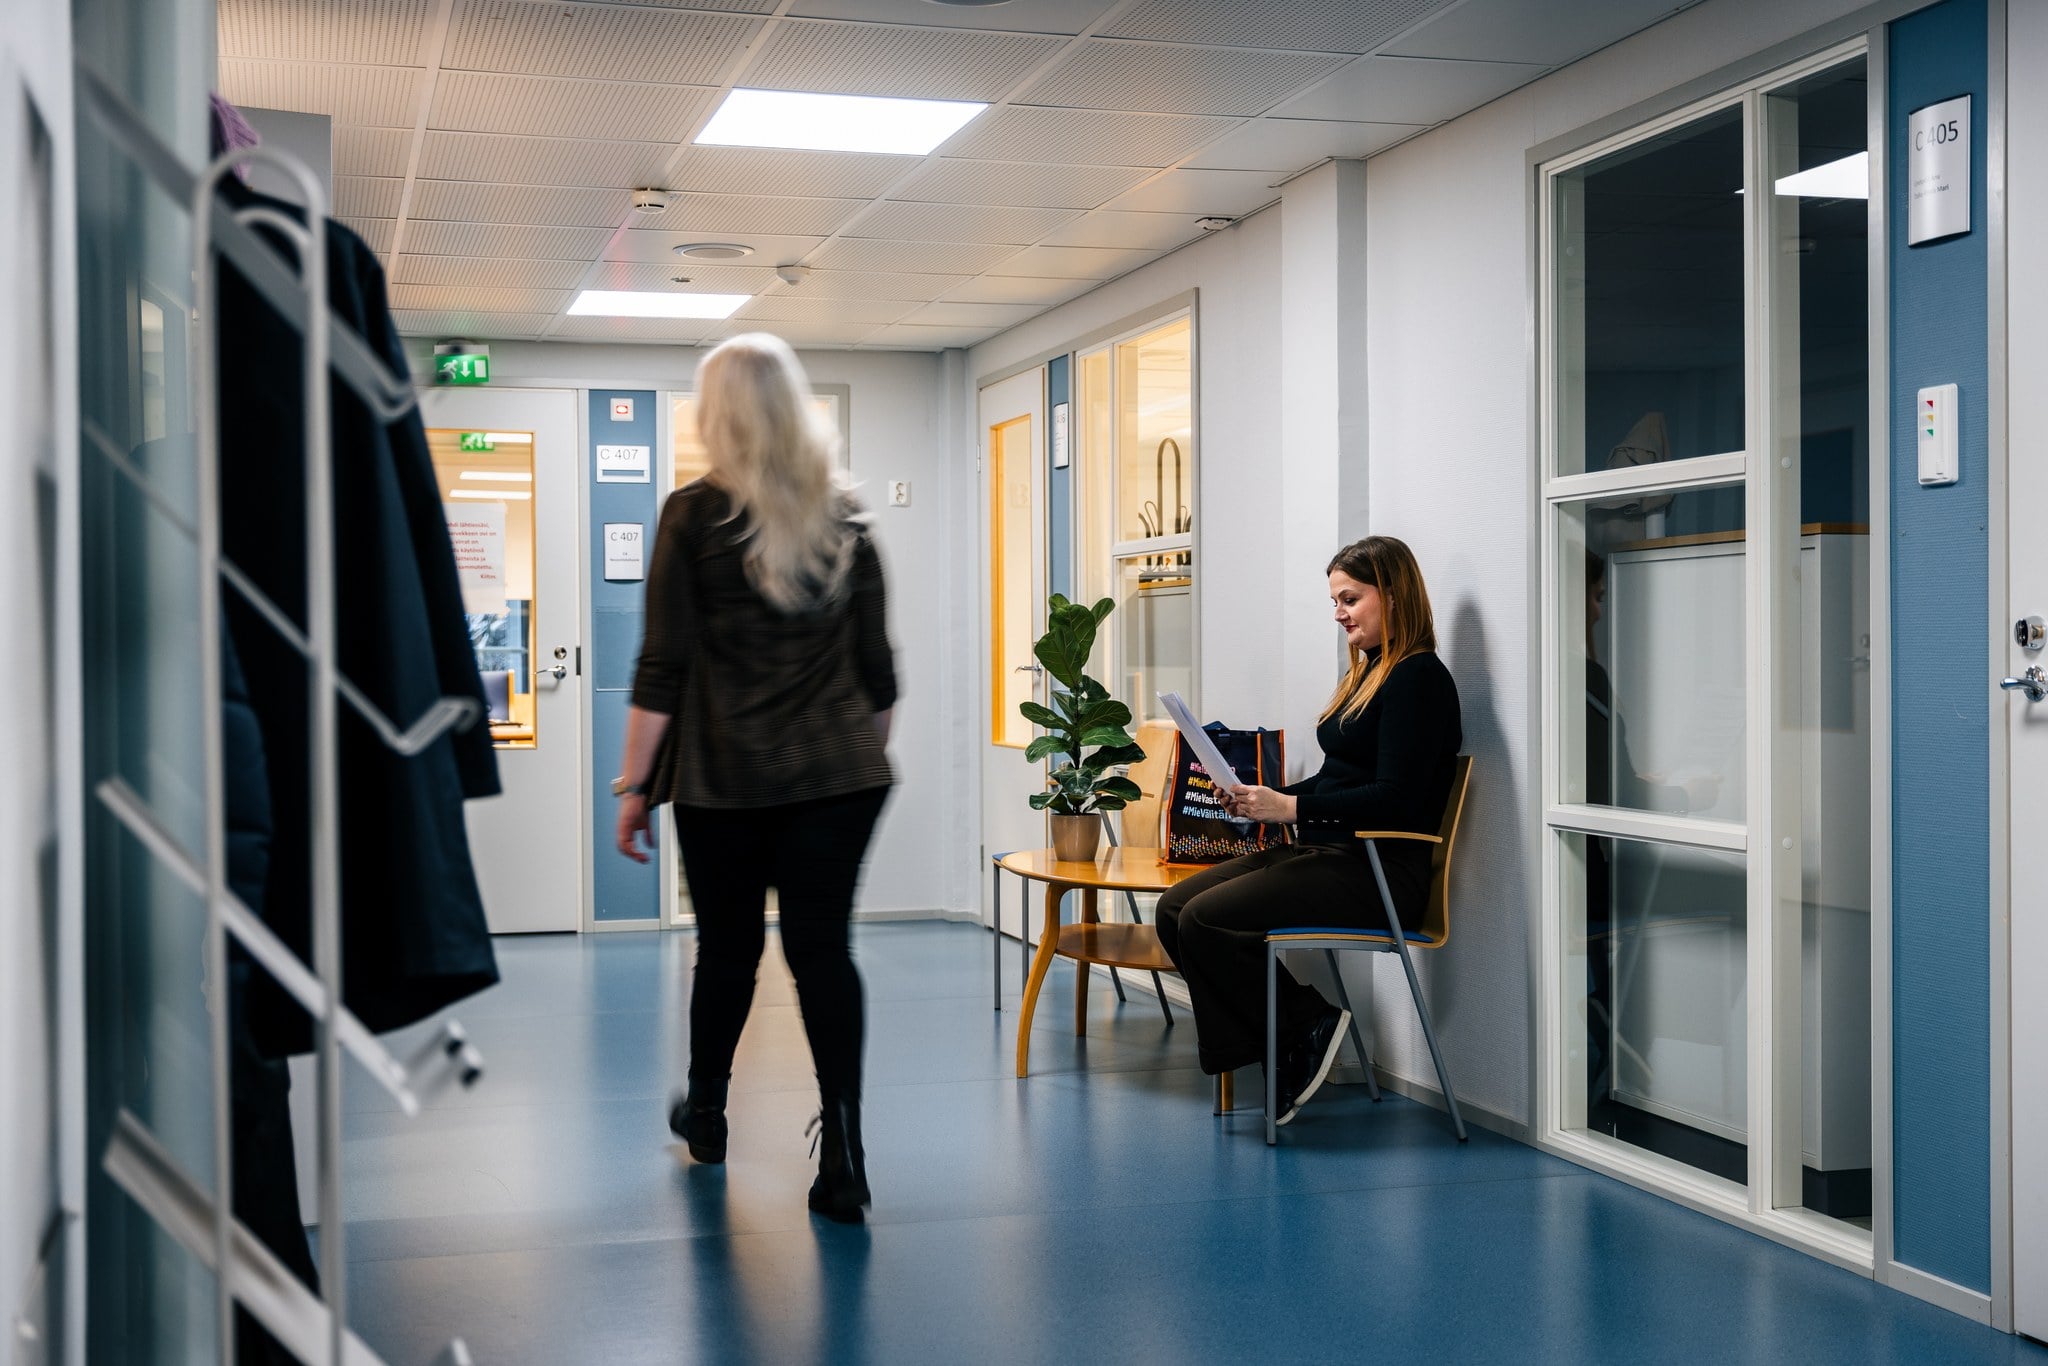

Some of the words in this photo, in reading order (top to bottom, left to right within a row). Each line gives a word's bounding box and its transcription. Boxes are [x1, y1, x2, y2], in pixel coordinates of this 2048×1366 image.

[1915, 131, 1923, 151] C
[1927, 120, 1958, 146] 405
[601, 449, 610, 460] C
[614, 448, 639, 460] 407
[610, 531, 618, 541] C
[620, 531, 639, 541] 407
